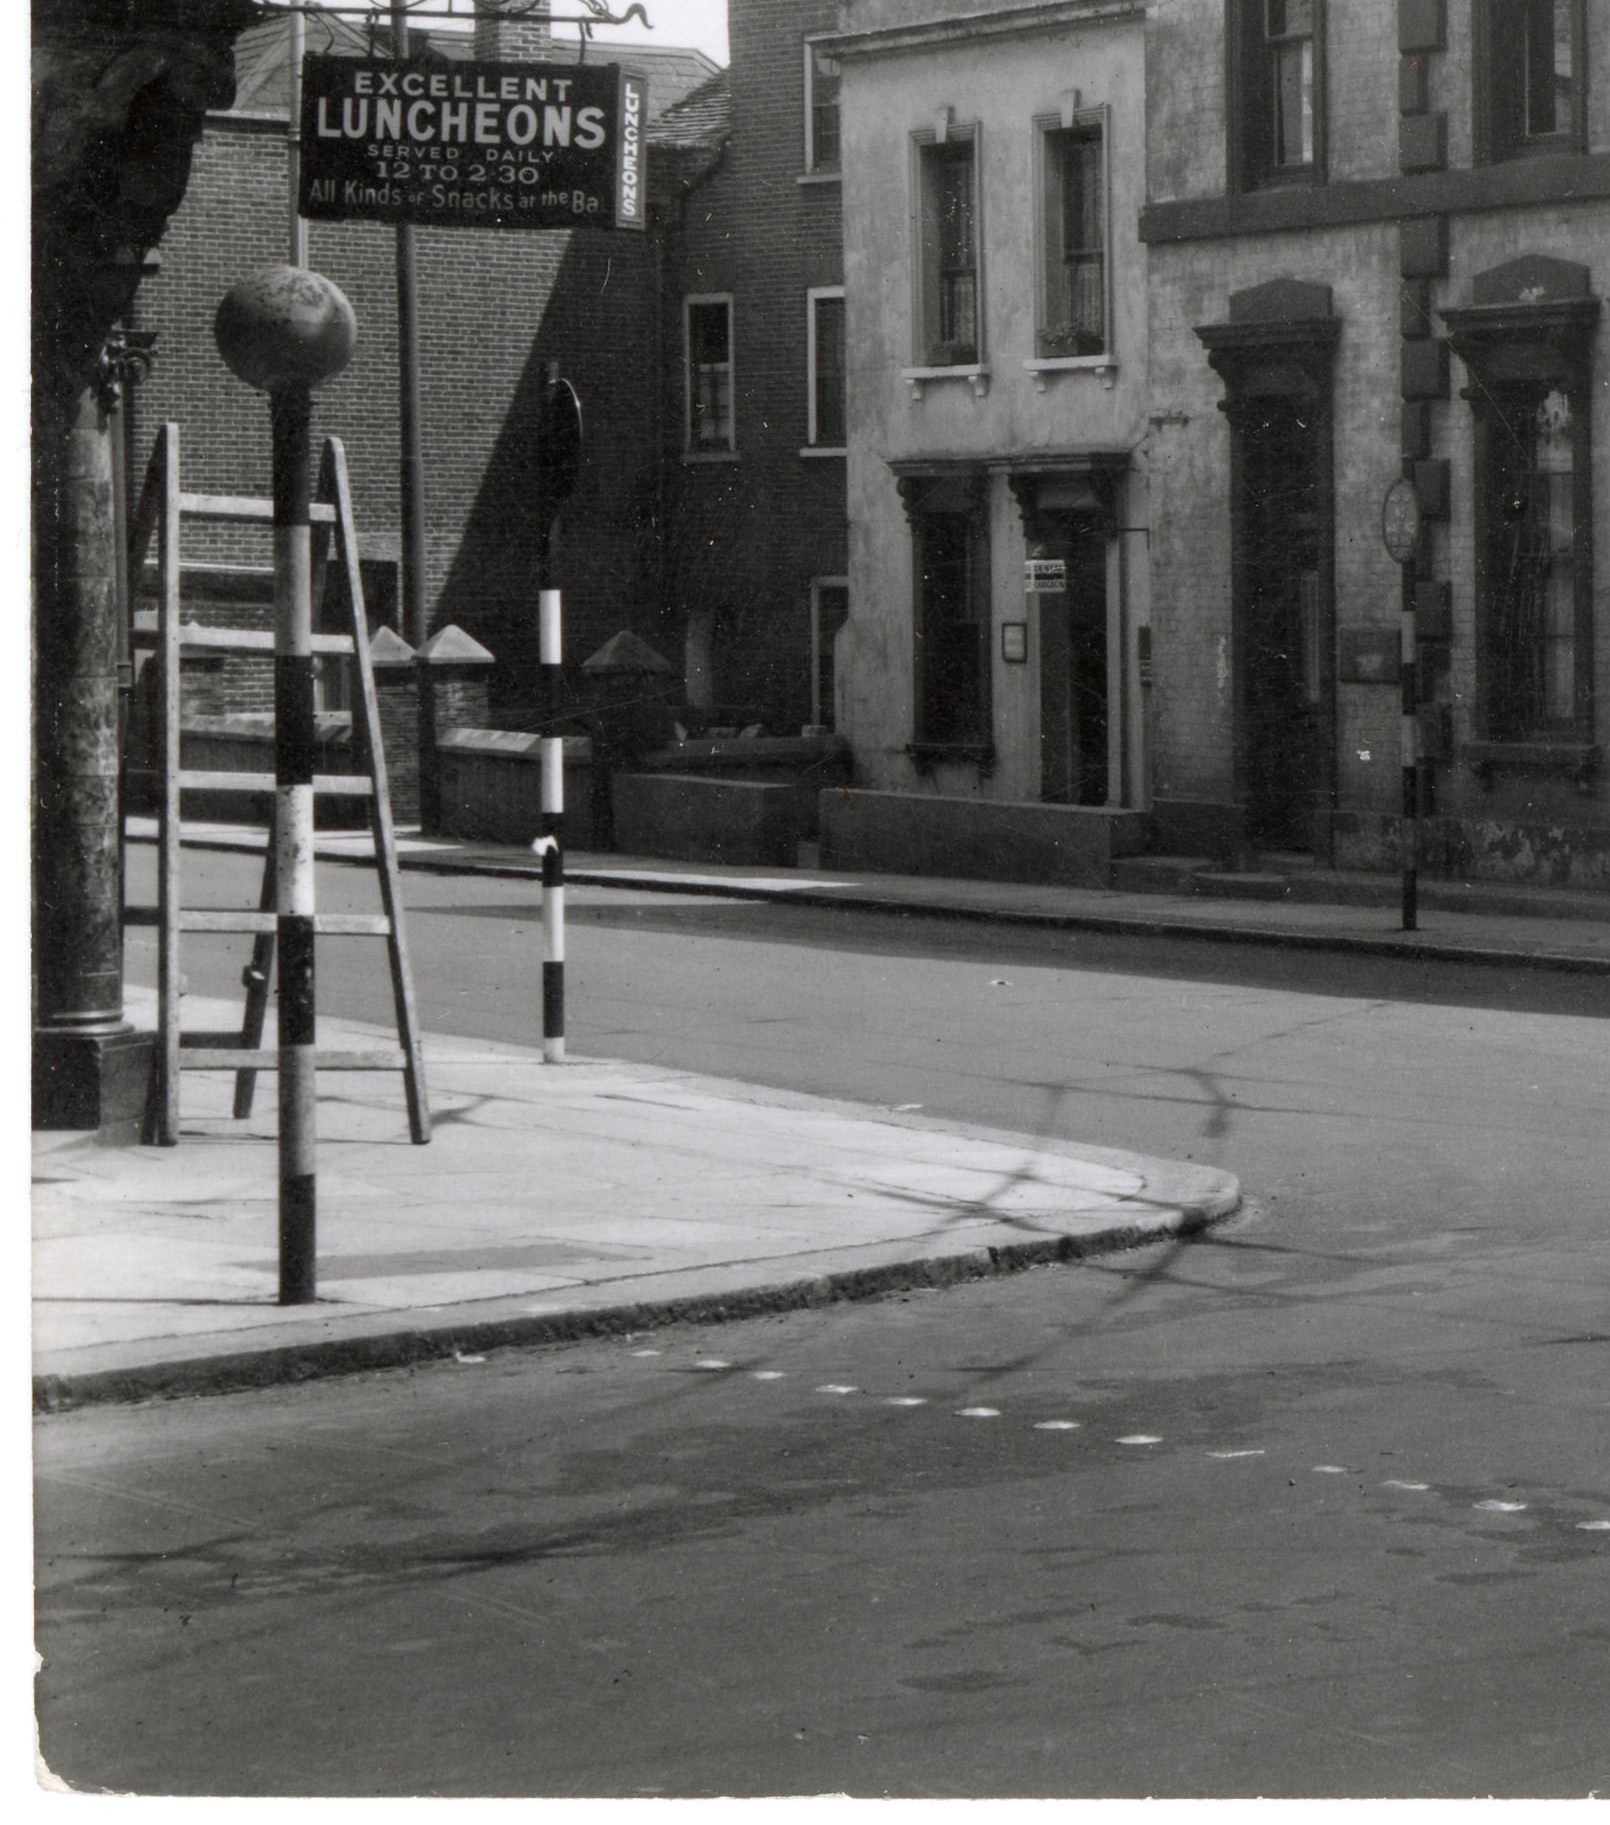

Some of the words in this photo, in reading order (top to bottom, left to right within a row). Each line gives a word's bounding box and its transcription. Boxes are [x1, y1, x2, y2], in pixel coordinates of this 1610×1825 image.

[354, 71, 573, 102] EXCELLENT
[317, 96, 606, 149] LUNCHEONS
[367, 143, 460, 159] SERVED
[486, 149, 554, 163] DAILY
[621, 82, 640, 217] LUNCHEONS
[376, 161, 411, 179] 12
[418, 164, 458, 182] TO
[310, 179, 336, 203] All
[344, 179, 403, 206] Kinds
[408, 191, 425, 206] of
[431, 183, 514, 211] Snacks
[518, 194, 537, 209] at
[541, 189, 569, 207] the
